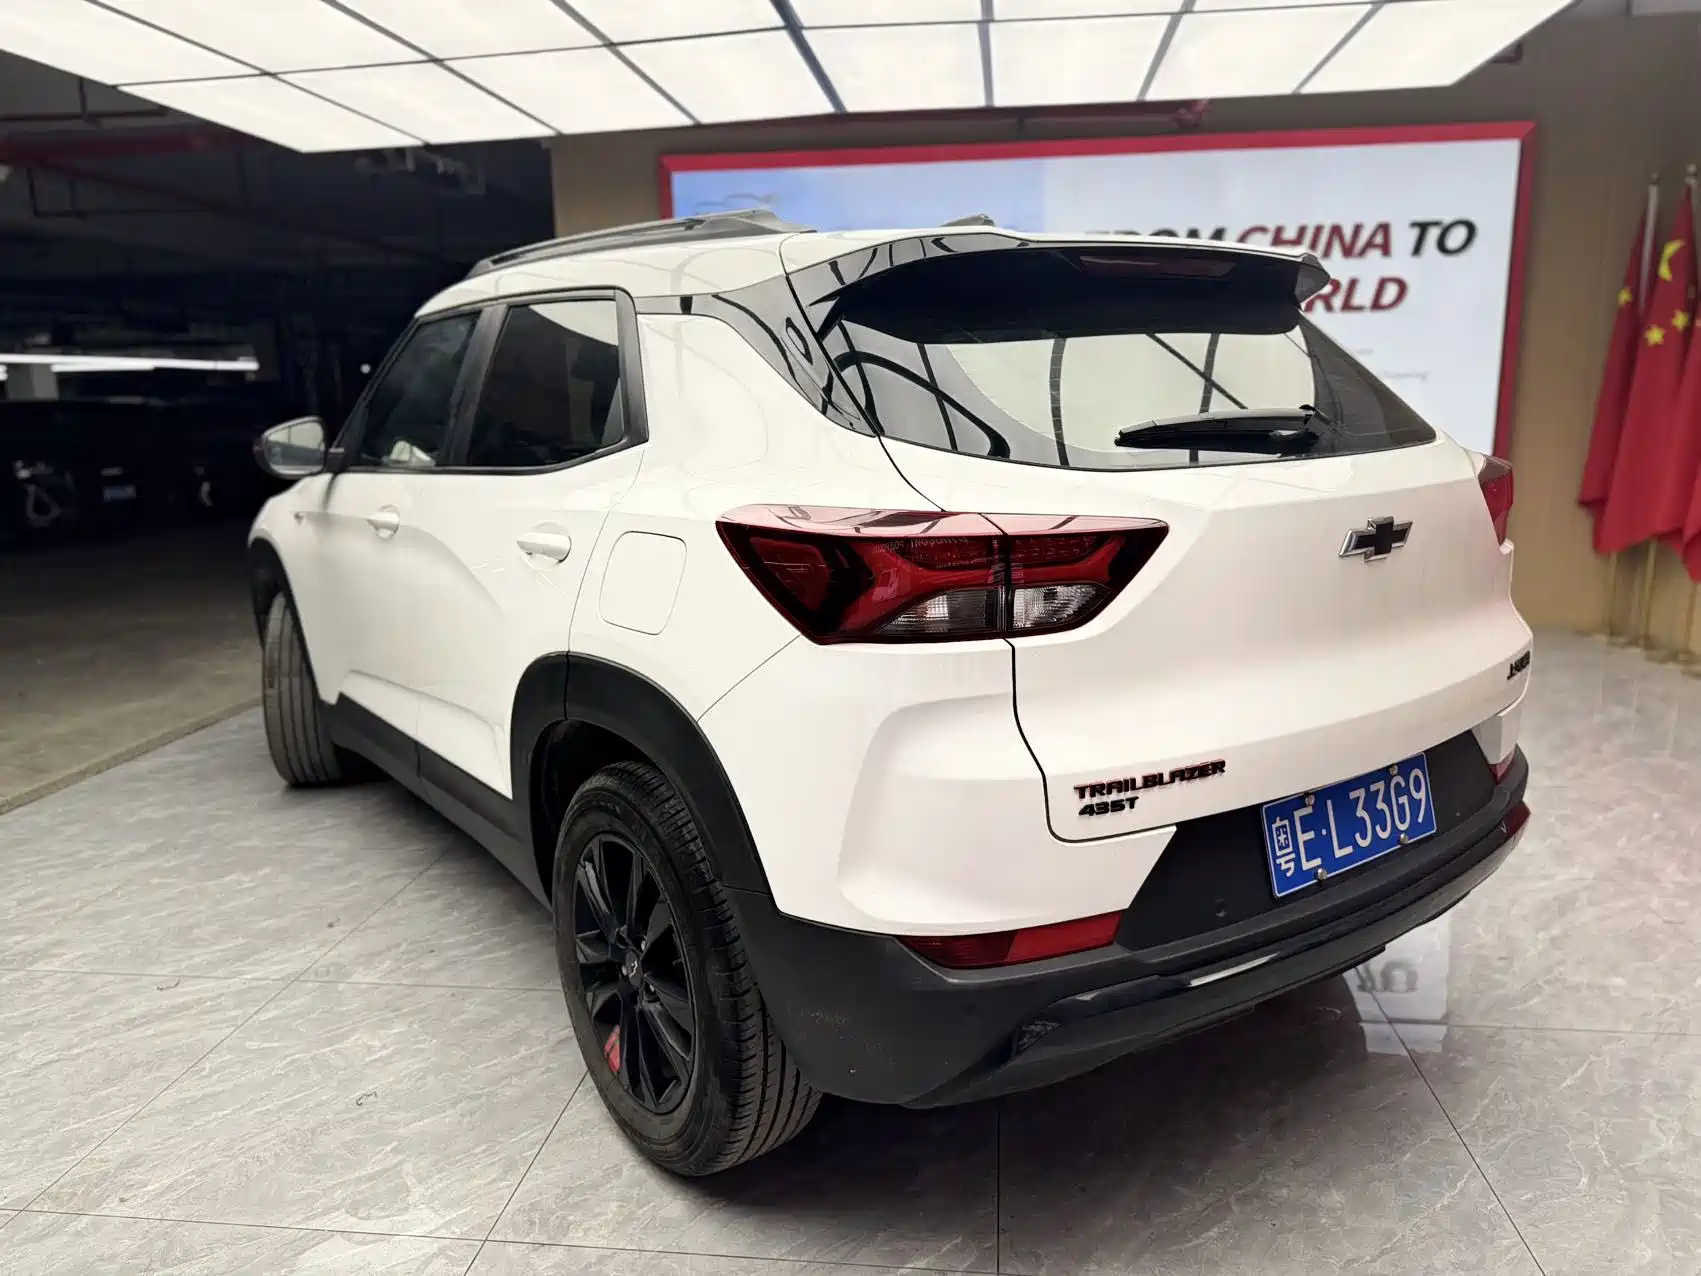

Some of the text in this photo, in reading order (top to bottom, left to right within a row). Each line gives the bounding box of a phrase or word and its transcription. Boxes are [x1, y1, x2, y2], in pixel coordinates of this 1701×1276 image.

[1408, 218, 1478, 258] TO
[1303, 275, 1408, 313] RLD
[1073, 758, 1226, 799] TRAILBLAZER
[1078, 796, 1139, 816] 435T
